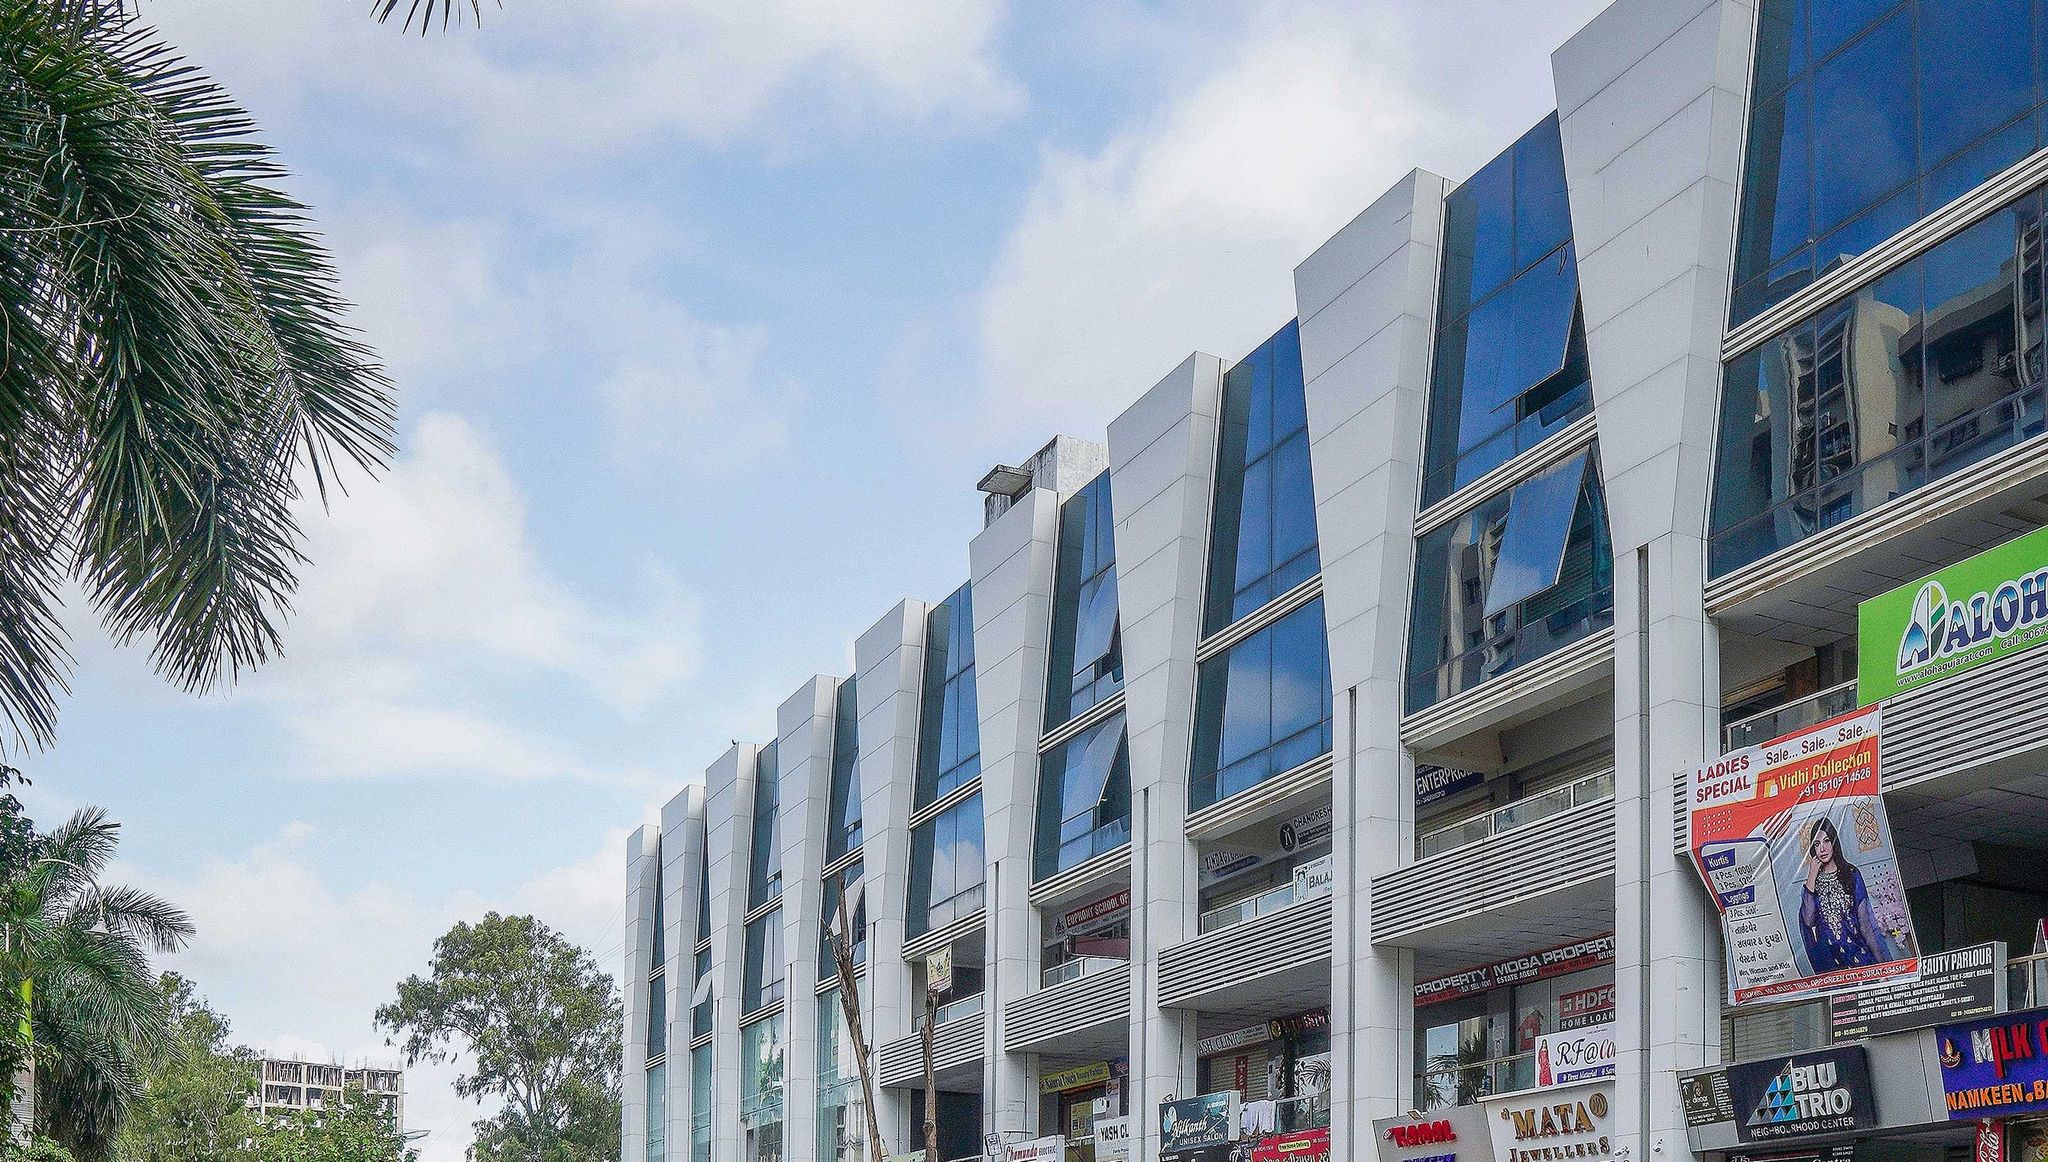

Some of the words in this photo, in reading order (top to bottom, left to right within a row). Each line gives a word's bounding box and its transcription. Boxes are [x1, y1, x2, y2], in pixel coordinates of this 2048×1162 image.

[1896, 646, 1993, 686] www.alohagujarat.com
[1766, 749, 1798, 766] Sale...
[1801, 736, 1835, 754] Sale...
[1838, 723, 1872, 743] Sale...
[1697, 754, 1750, 784] LADIES
[1779, 767, 1809, 791] Vidhi
[1696, 774, 1750, 803] SPECIAL
[1817, 776, 1843, 794] 95105
[1708, 855, 1729, 868] Kurtis
[1094, 896, 1119, 915] SCHOOL
[1119, 892, 1130, 905] OF
[1920, 954, 1950, 976] EAUTY
[1951, 946, 1992, 970] PARLOUR
[1414, 967, 1487, 996] PROPERTY
[1493, 955, 1541, 976] MOGA
[1496, 973, 1518, 985] ESTATE
[1520, 968, 1539, 979] AGENT
[1561, 1016, 1587, 1029] HOME
[1214, 1031, 1242, 1050] CLINIC
[1793, 1061, 1838, 1092] BLU
[1795, 1088, 1852, 1119] TRIO
[1510, 1101, 1596, 1140] MATA
[1821, 1116, 1855, 1130] CENTER
[1100, 1125, 1118, 1142] YASH
[1180, 1136, 1202, 1146] UNISEX
[1509, 1136, 1610, 1162] JEWELLERS
